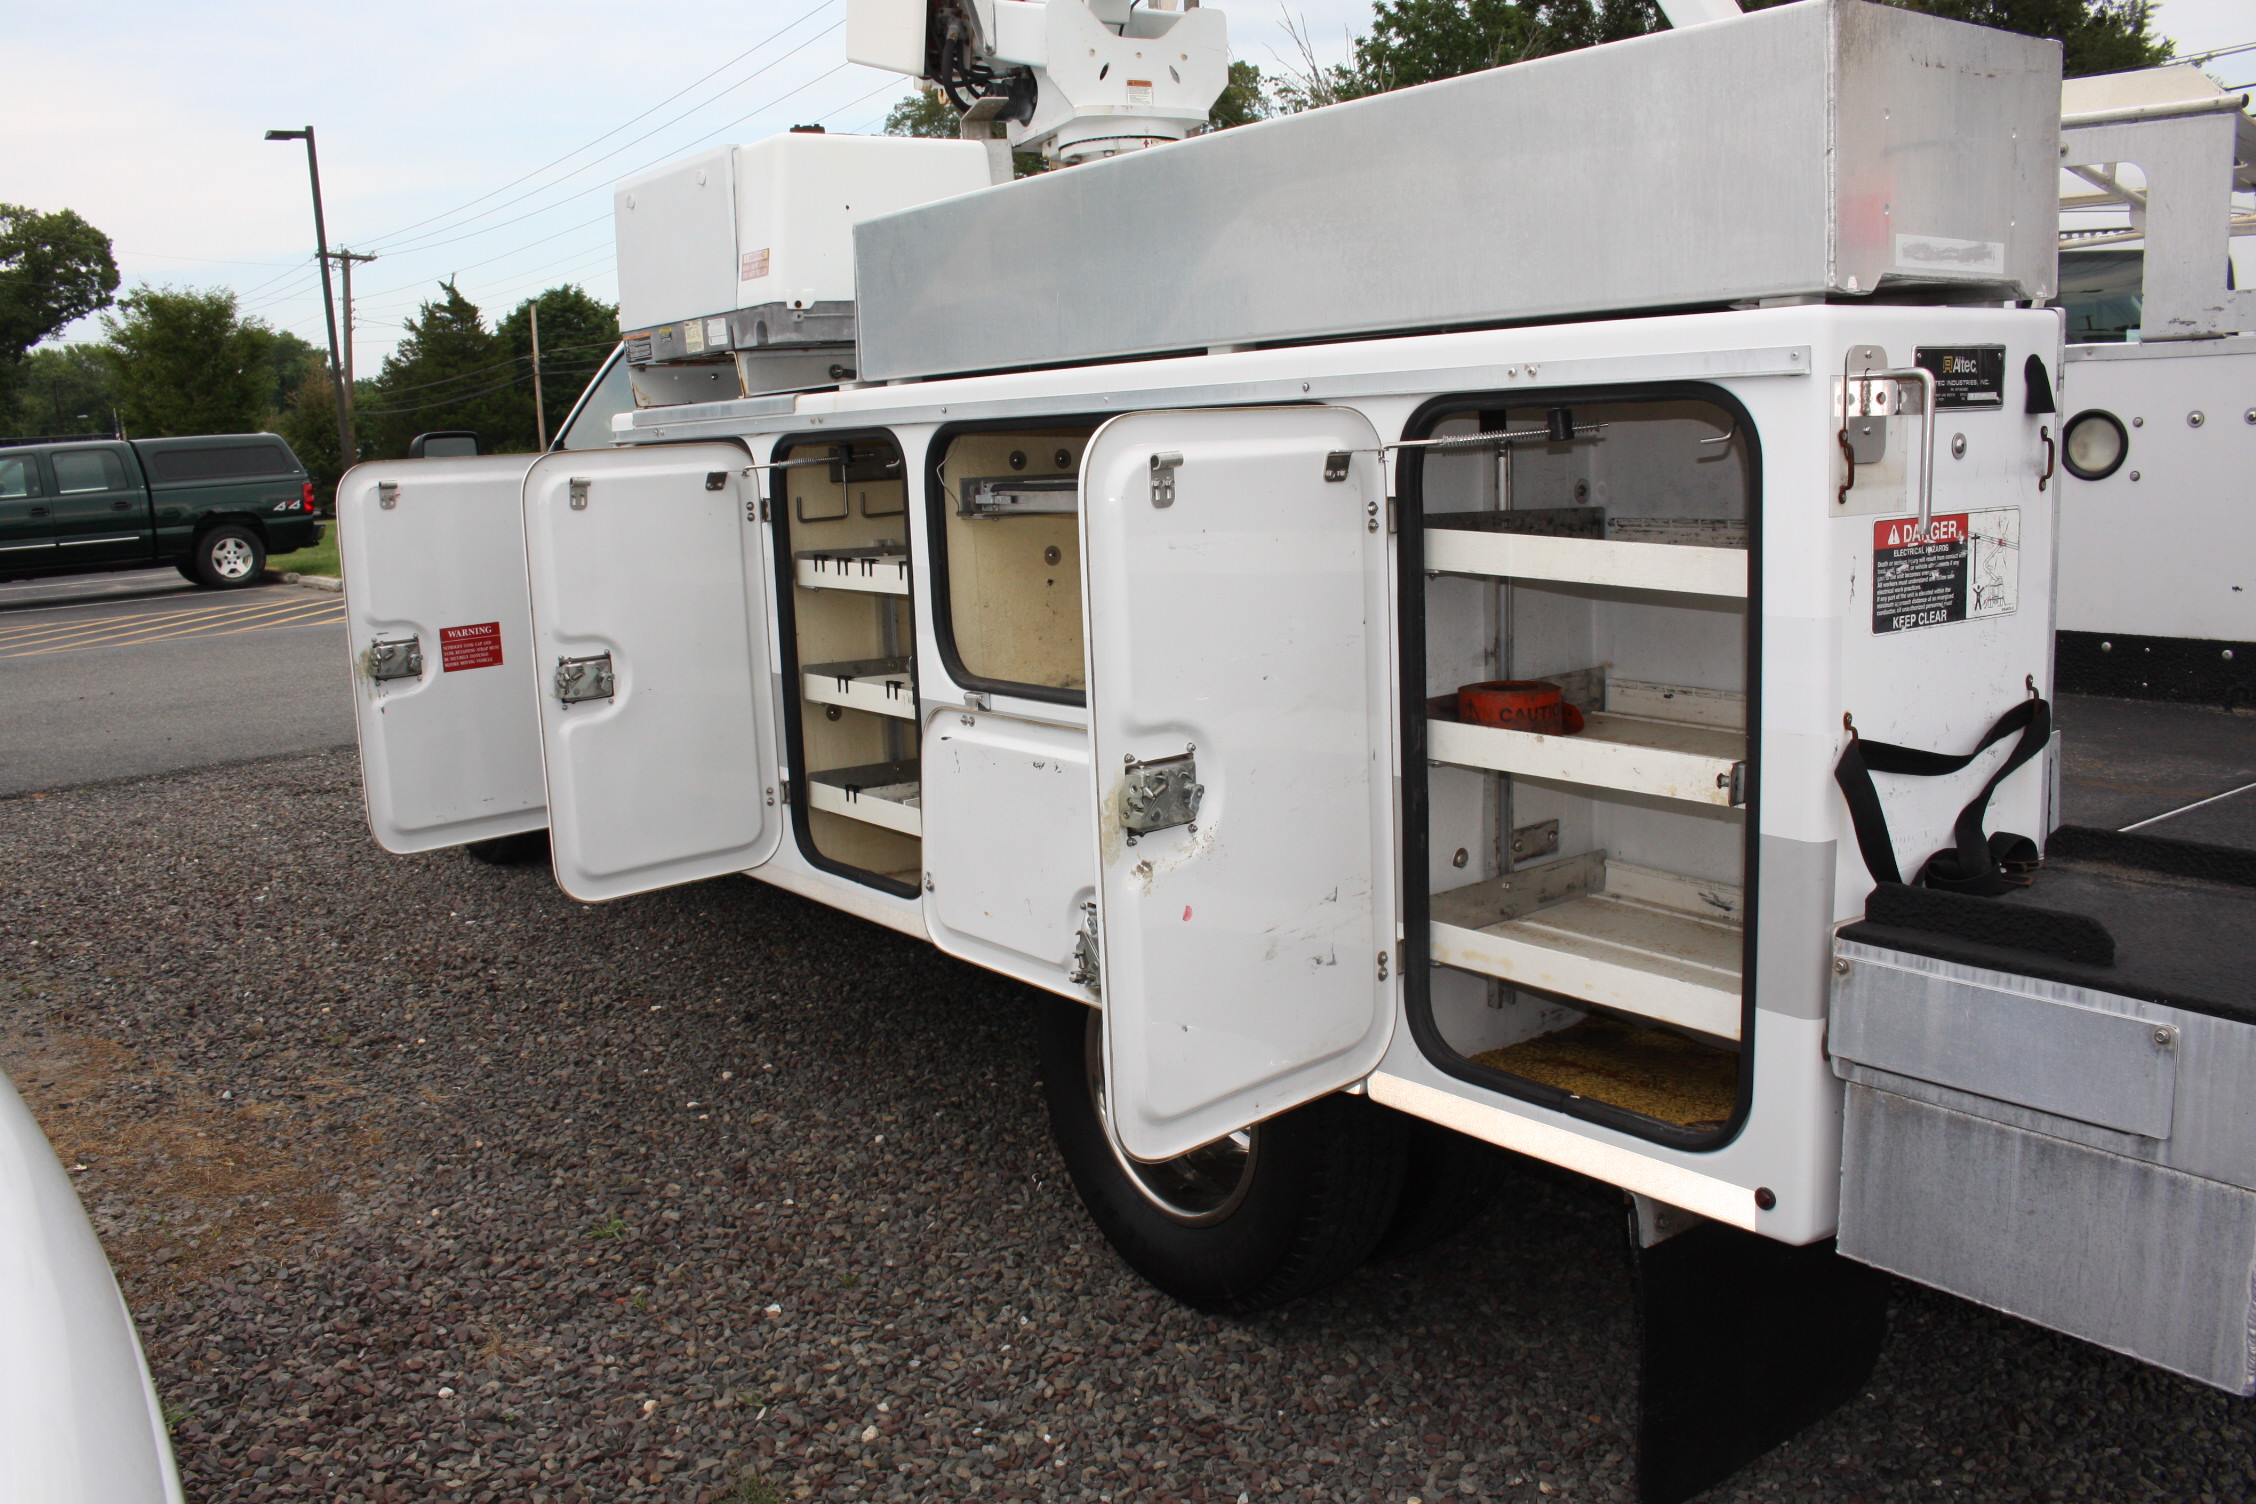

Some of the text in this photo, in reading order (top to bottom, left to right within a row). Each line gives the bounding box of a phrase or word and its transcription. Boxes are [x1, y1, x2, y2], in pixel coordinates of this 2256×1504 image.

[1953, 356, 1977, 373] Altec
[1893, 546, 1924, 557] ELECTRICAL
[1892, 609, 1947, 630] KEEP CLEAR
[448, 626, 492, 637] WARNING
